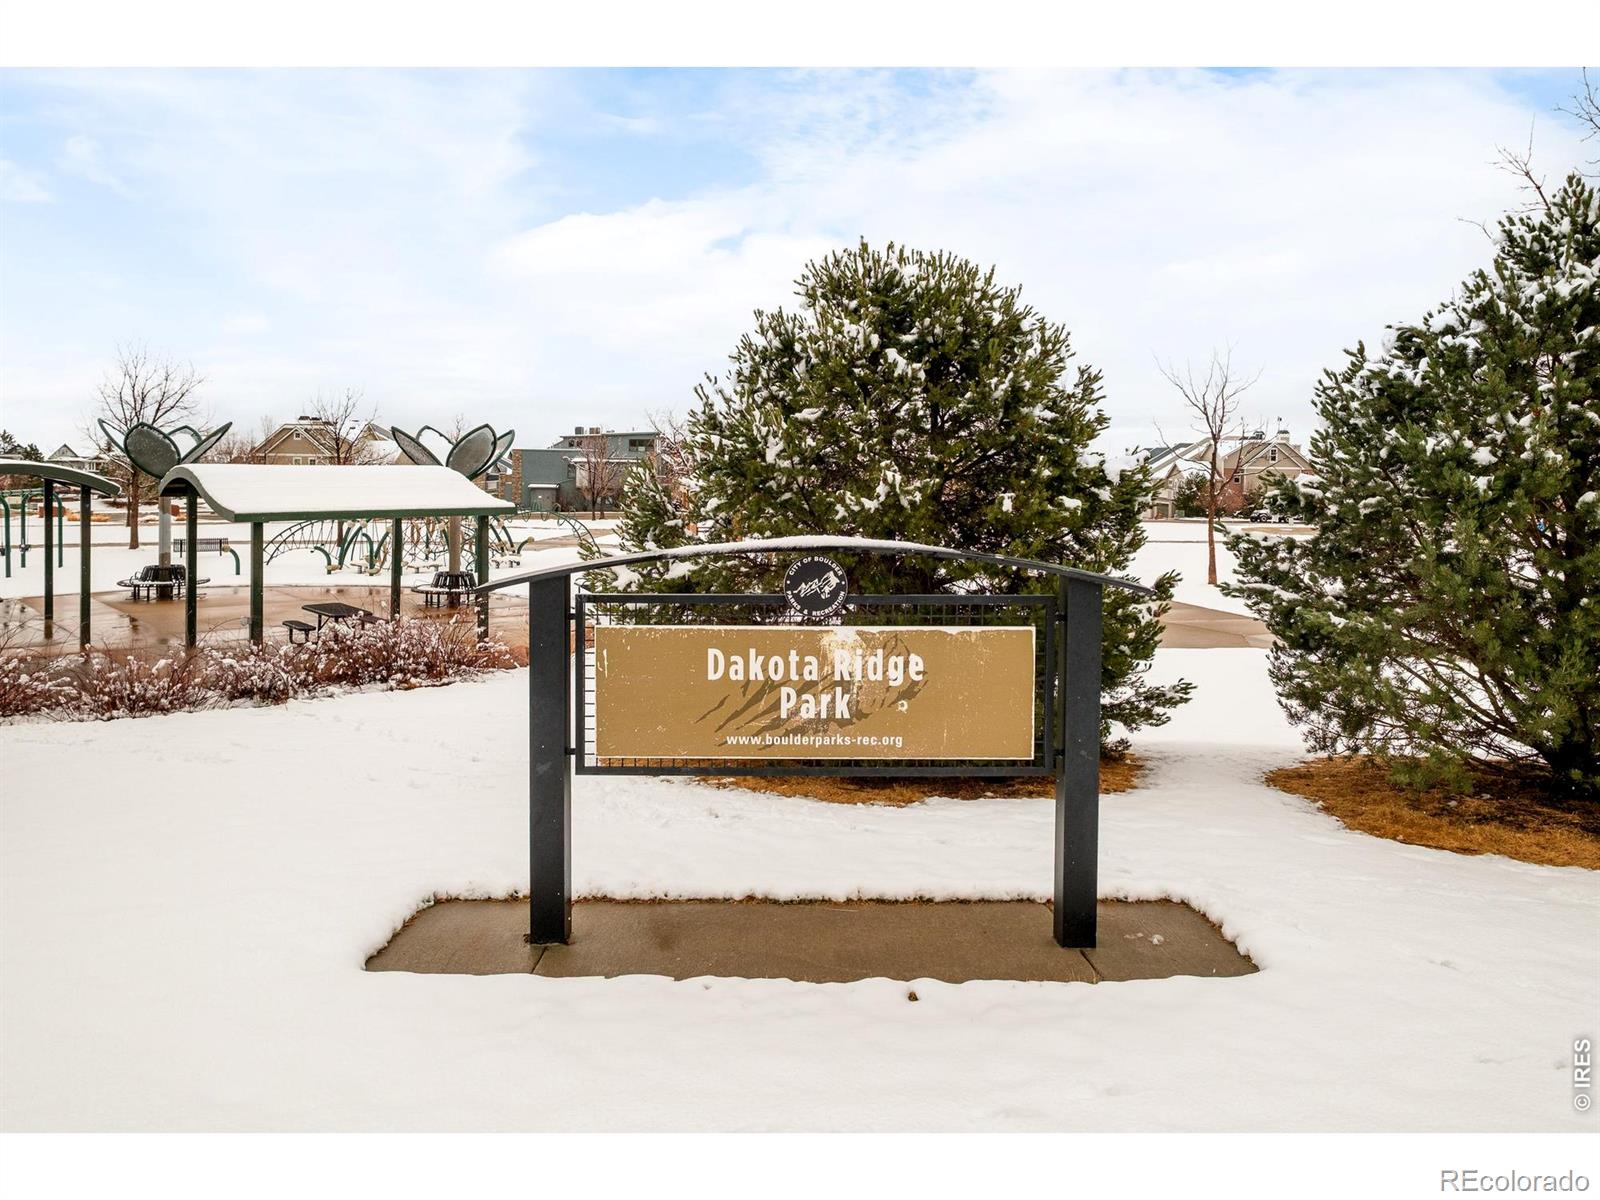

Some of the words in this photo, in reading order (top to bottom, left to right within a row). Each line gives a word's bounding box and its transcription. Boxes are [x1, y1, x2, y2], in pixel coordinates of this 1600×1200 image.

[789, 561, 802, 576] CITY
[802, 556, 812, 564] OF
[814, 556, 843, 576] BOULDER
[786, 590, 801, 610] PARKS
[812, 591, 846, 616] RECREATION
[706, 648, 819, 681] Dakota
[833, 648, 925, 687] Ridge
[780, 686, 852, 719] Park
[726, 733, 903, 748] www.boulderparks-rec.org
